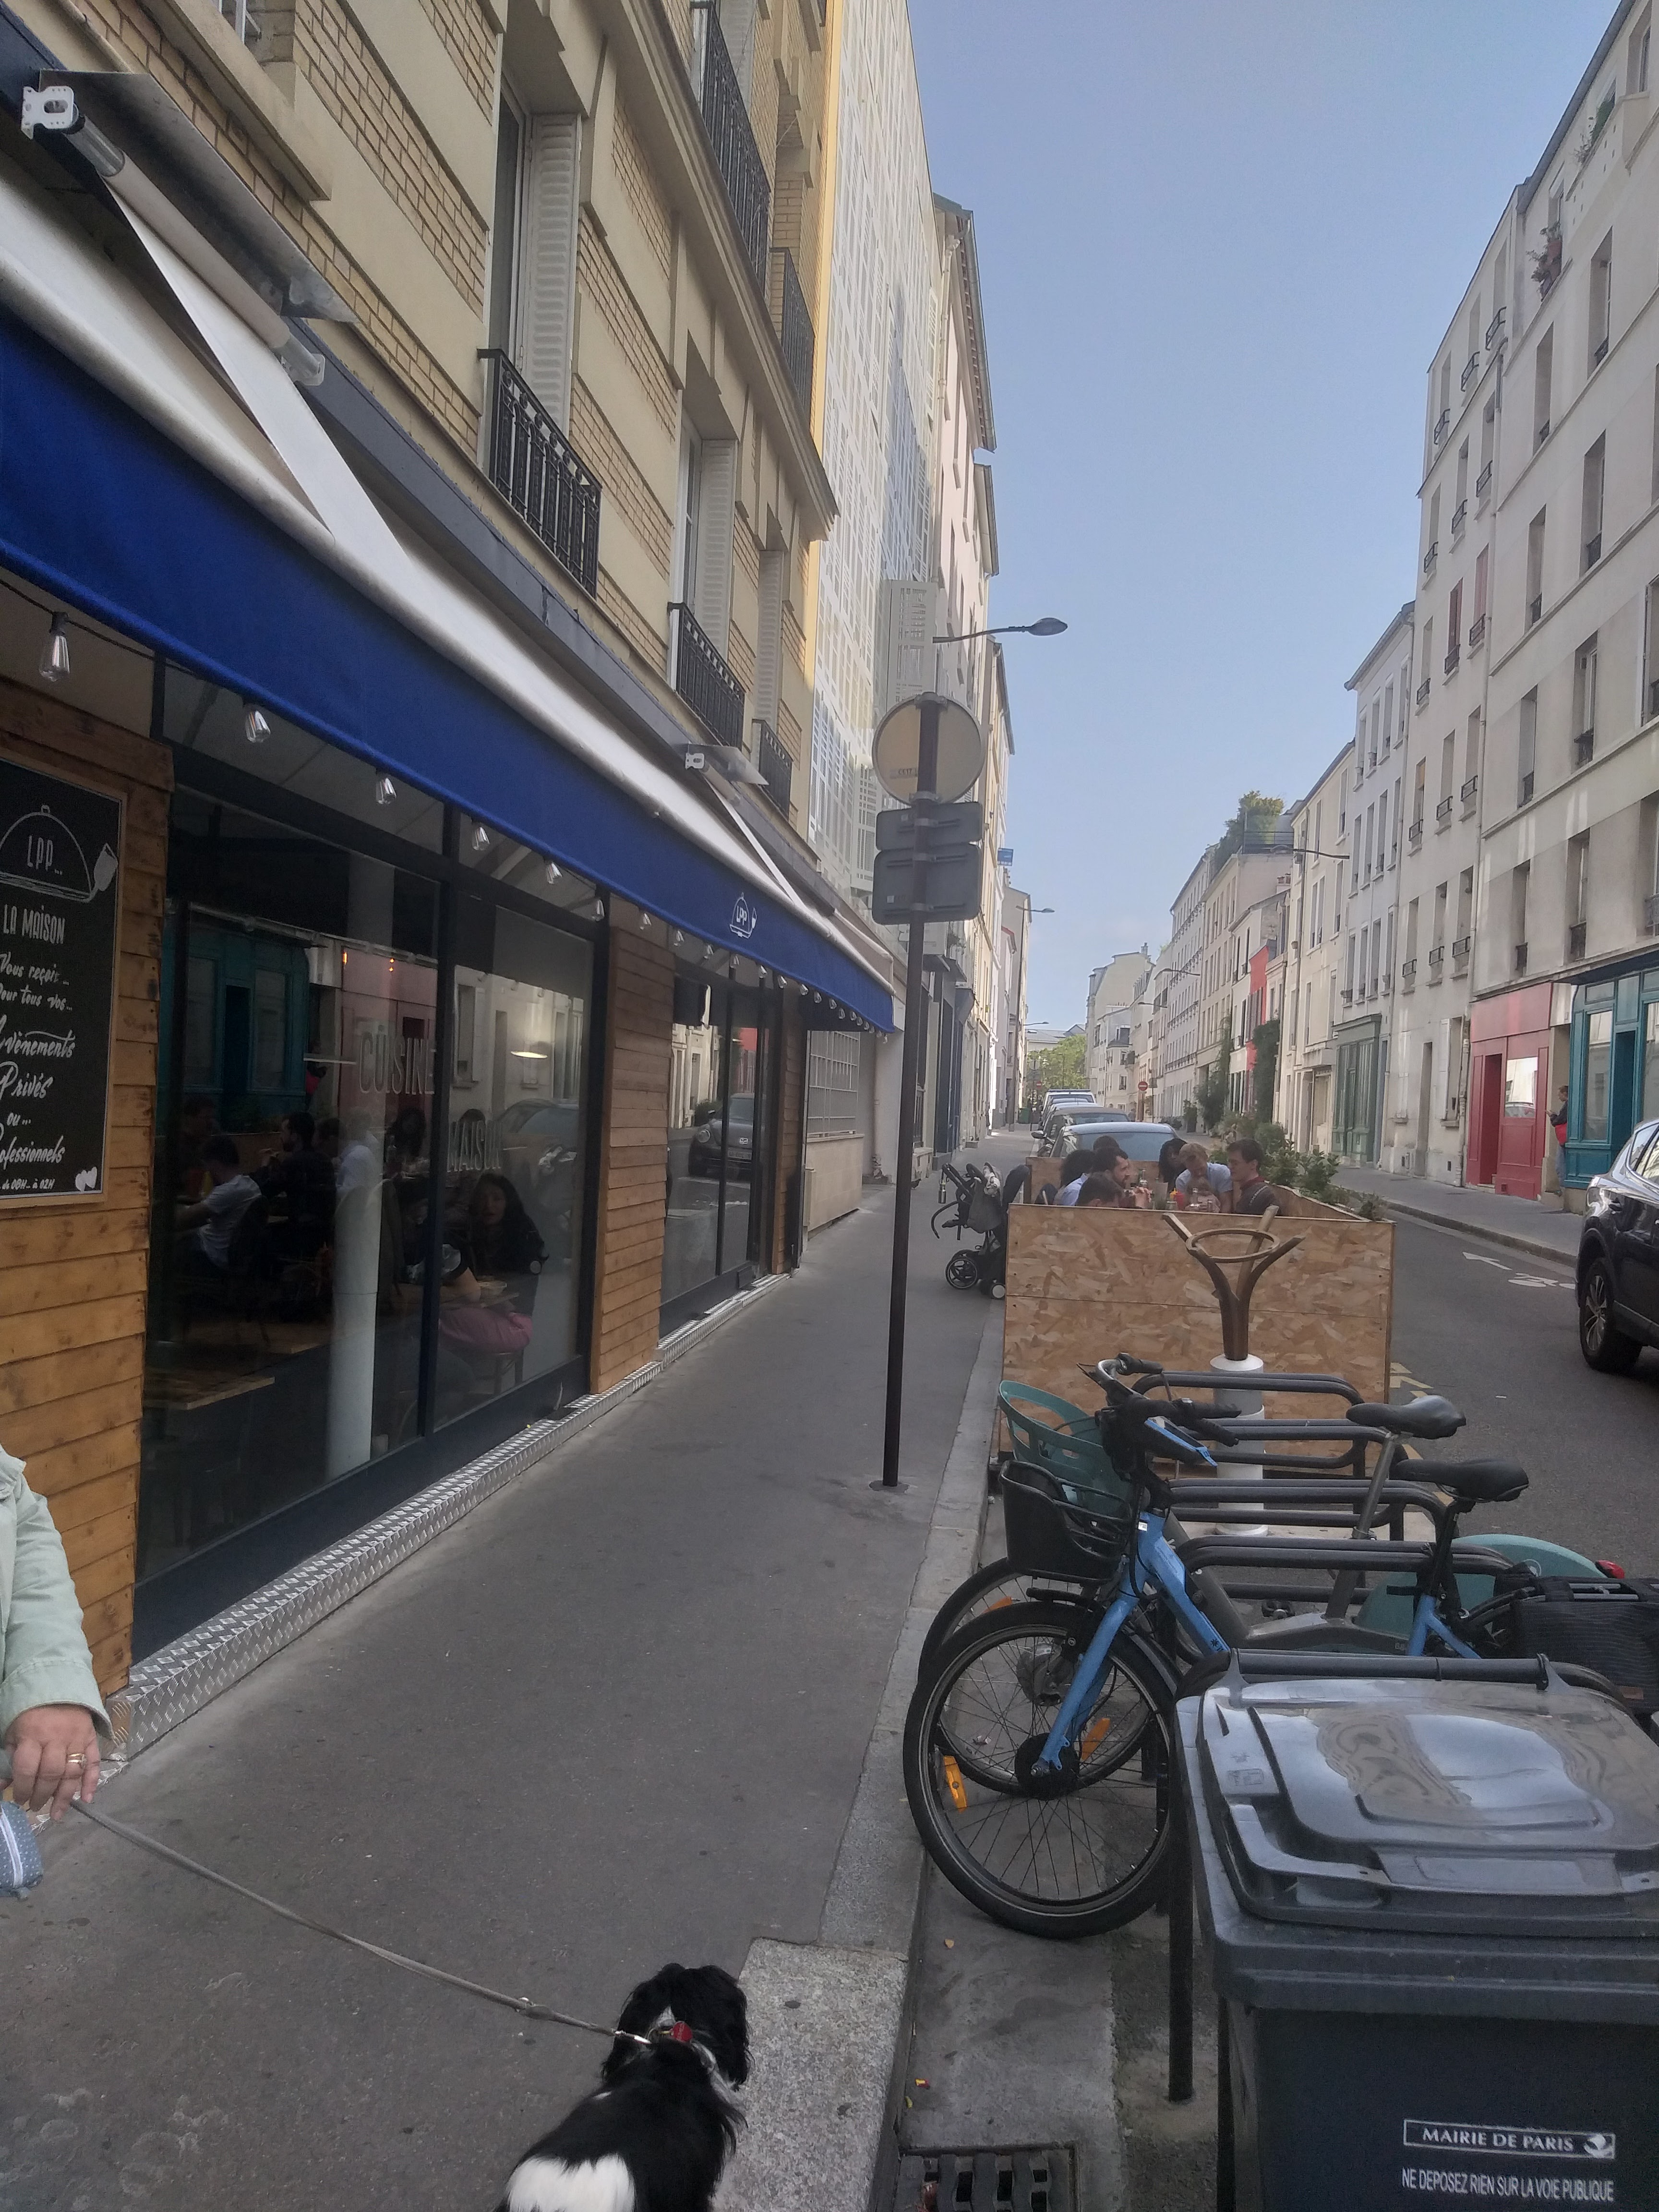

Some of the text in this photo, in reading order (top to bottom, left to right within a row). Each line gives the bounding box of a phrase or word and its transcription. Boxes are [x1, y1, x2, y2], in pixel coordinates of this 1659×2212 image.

[3, 903, 17, 935] LA
[736, 905, 747, 926] LPP
[20, 984, 42, 1007] tous
[0, 1061, 53, 1101] Privés
[446, 1119, 501, 1173] MAISON
[1422, 2127, 1575, 2152] MAIRIE DE PARIS
[1401, 2166, 1615, 2203] NE DEPOSEZ RIEN SUR LA VOIE PUBLIQUE
